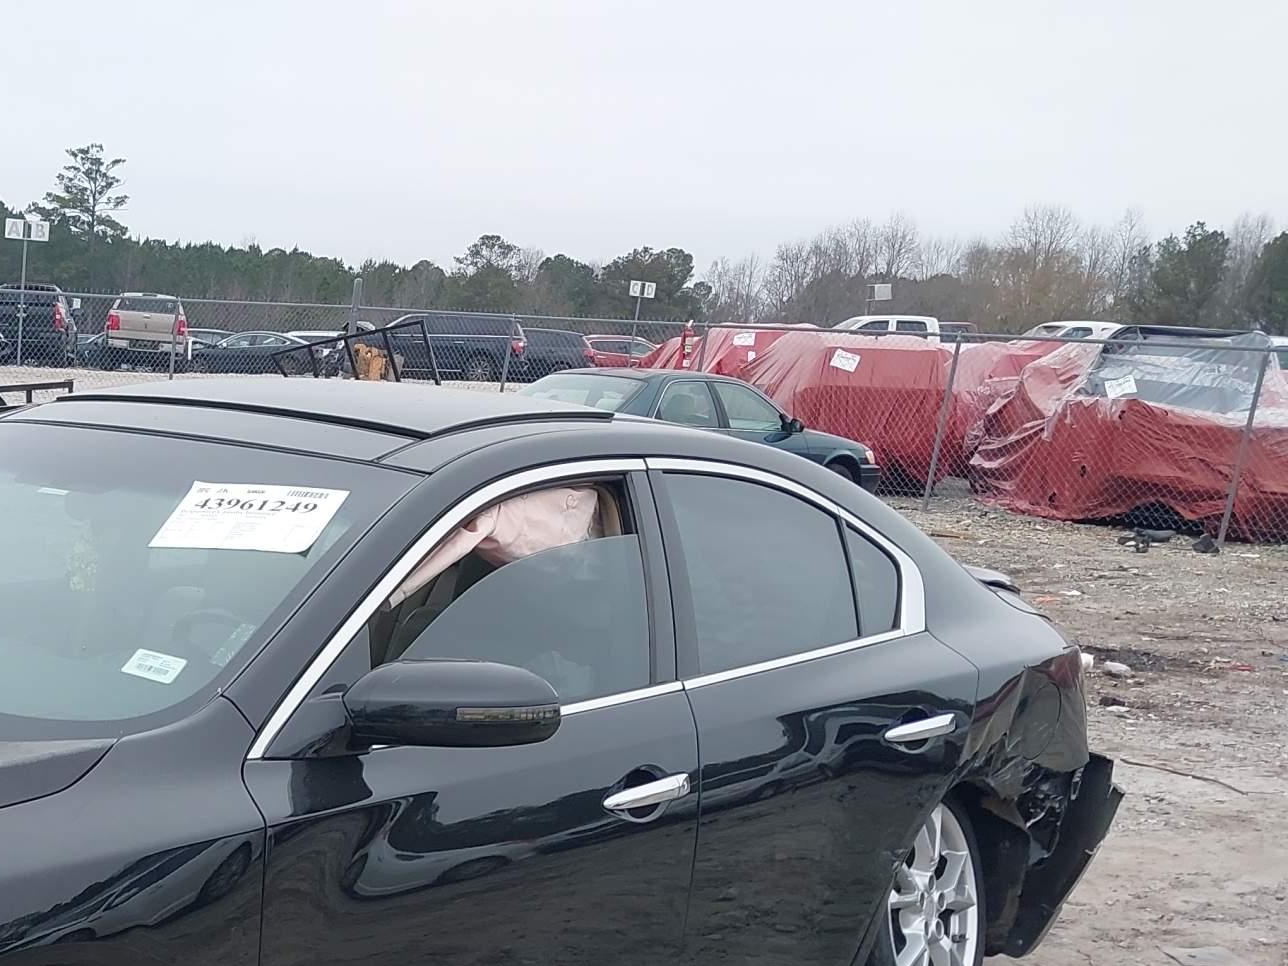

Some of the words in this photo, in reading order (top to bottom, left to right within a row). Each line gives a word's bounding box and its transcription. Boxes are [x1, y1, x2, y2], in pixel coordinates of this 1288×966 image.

[7, 220, 21, 237] A
[35, 223, 46, 239] B
[646, 283, 654, 297] D
[194, 497, 319, 514] 43961249
